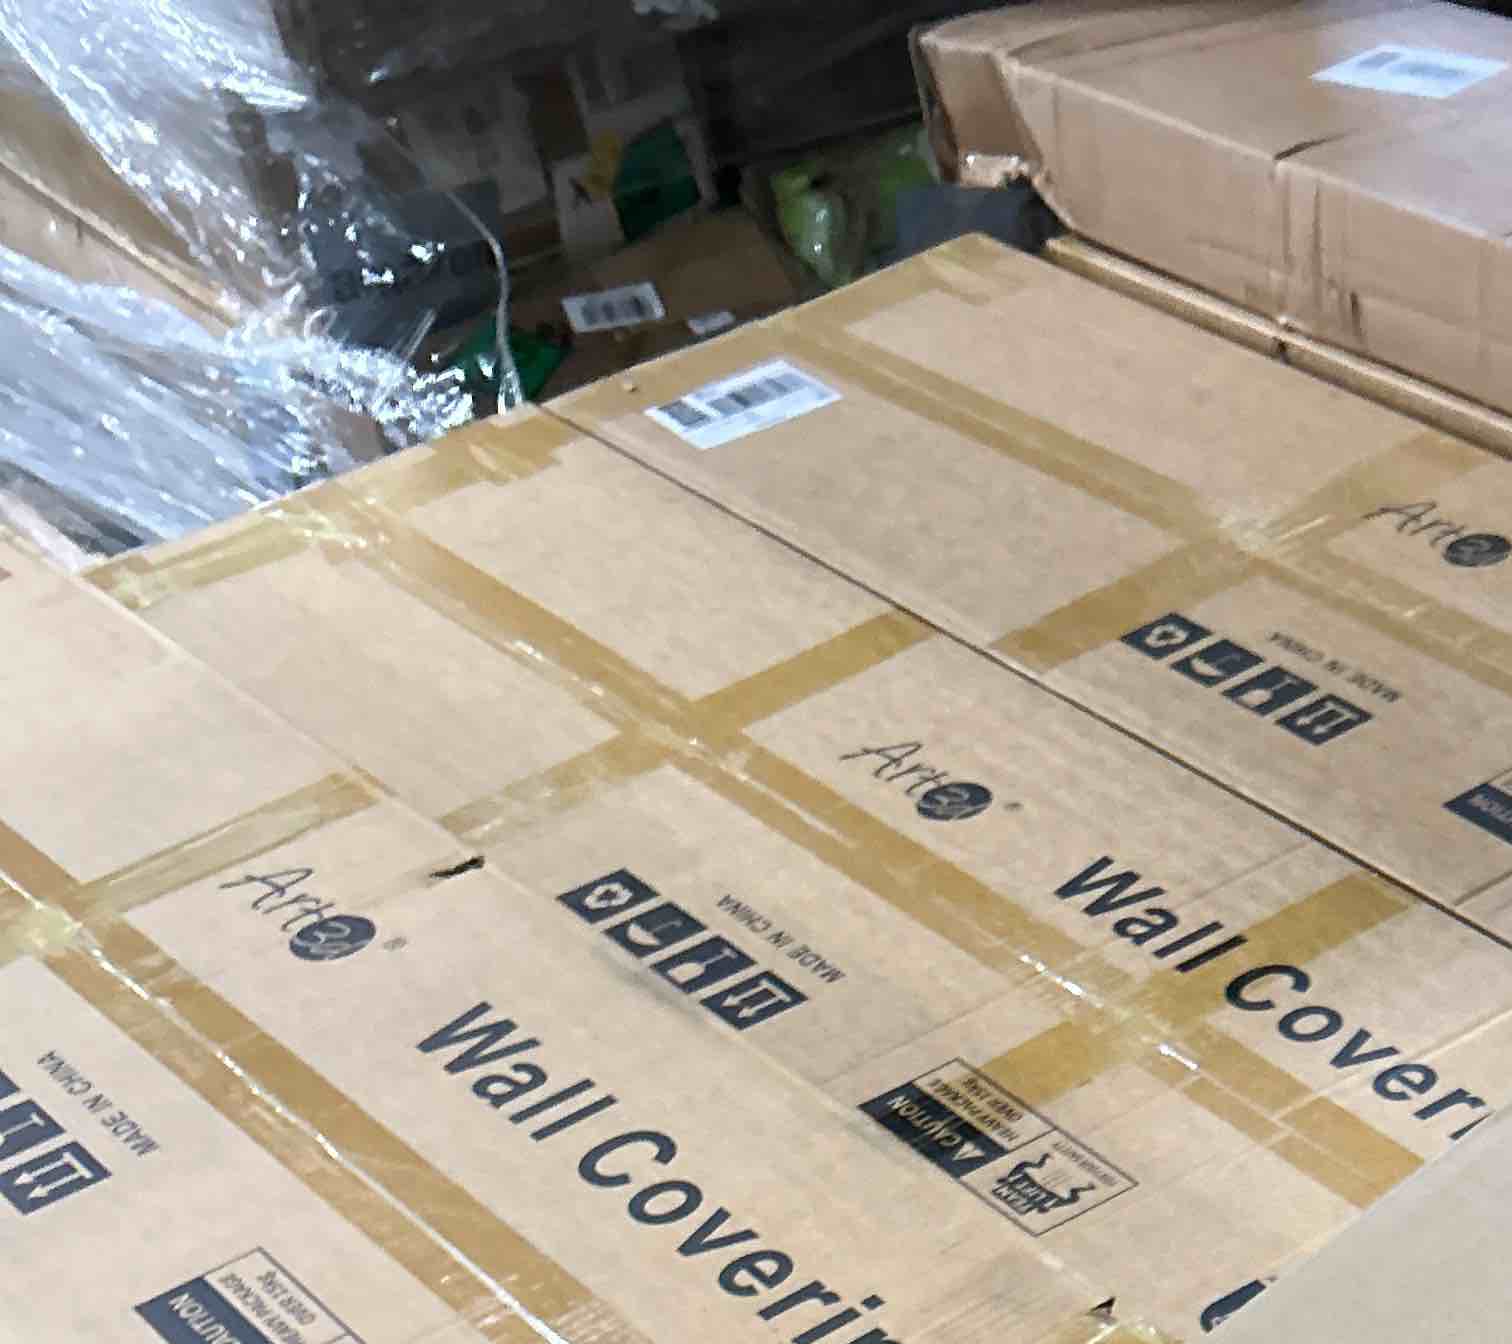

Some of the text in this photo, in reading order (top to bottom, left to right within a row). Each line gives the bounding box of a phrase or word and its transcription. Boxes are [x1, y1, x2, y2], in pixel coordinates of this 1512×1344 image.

[1053, 855, 1249, 974] Wall
[37, 1050, 93, 1096] CHINA
[416, 1001, 620, 1142] Wall
[100, 1110, 161, 1158] MADE
[888, 1093, 966, 1148] CAUTION
